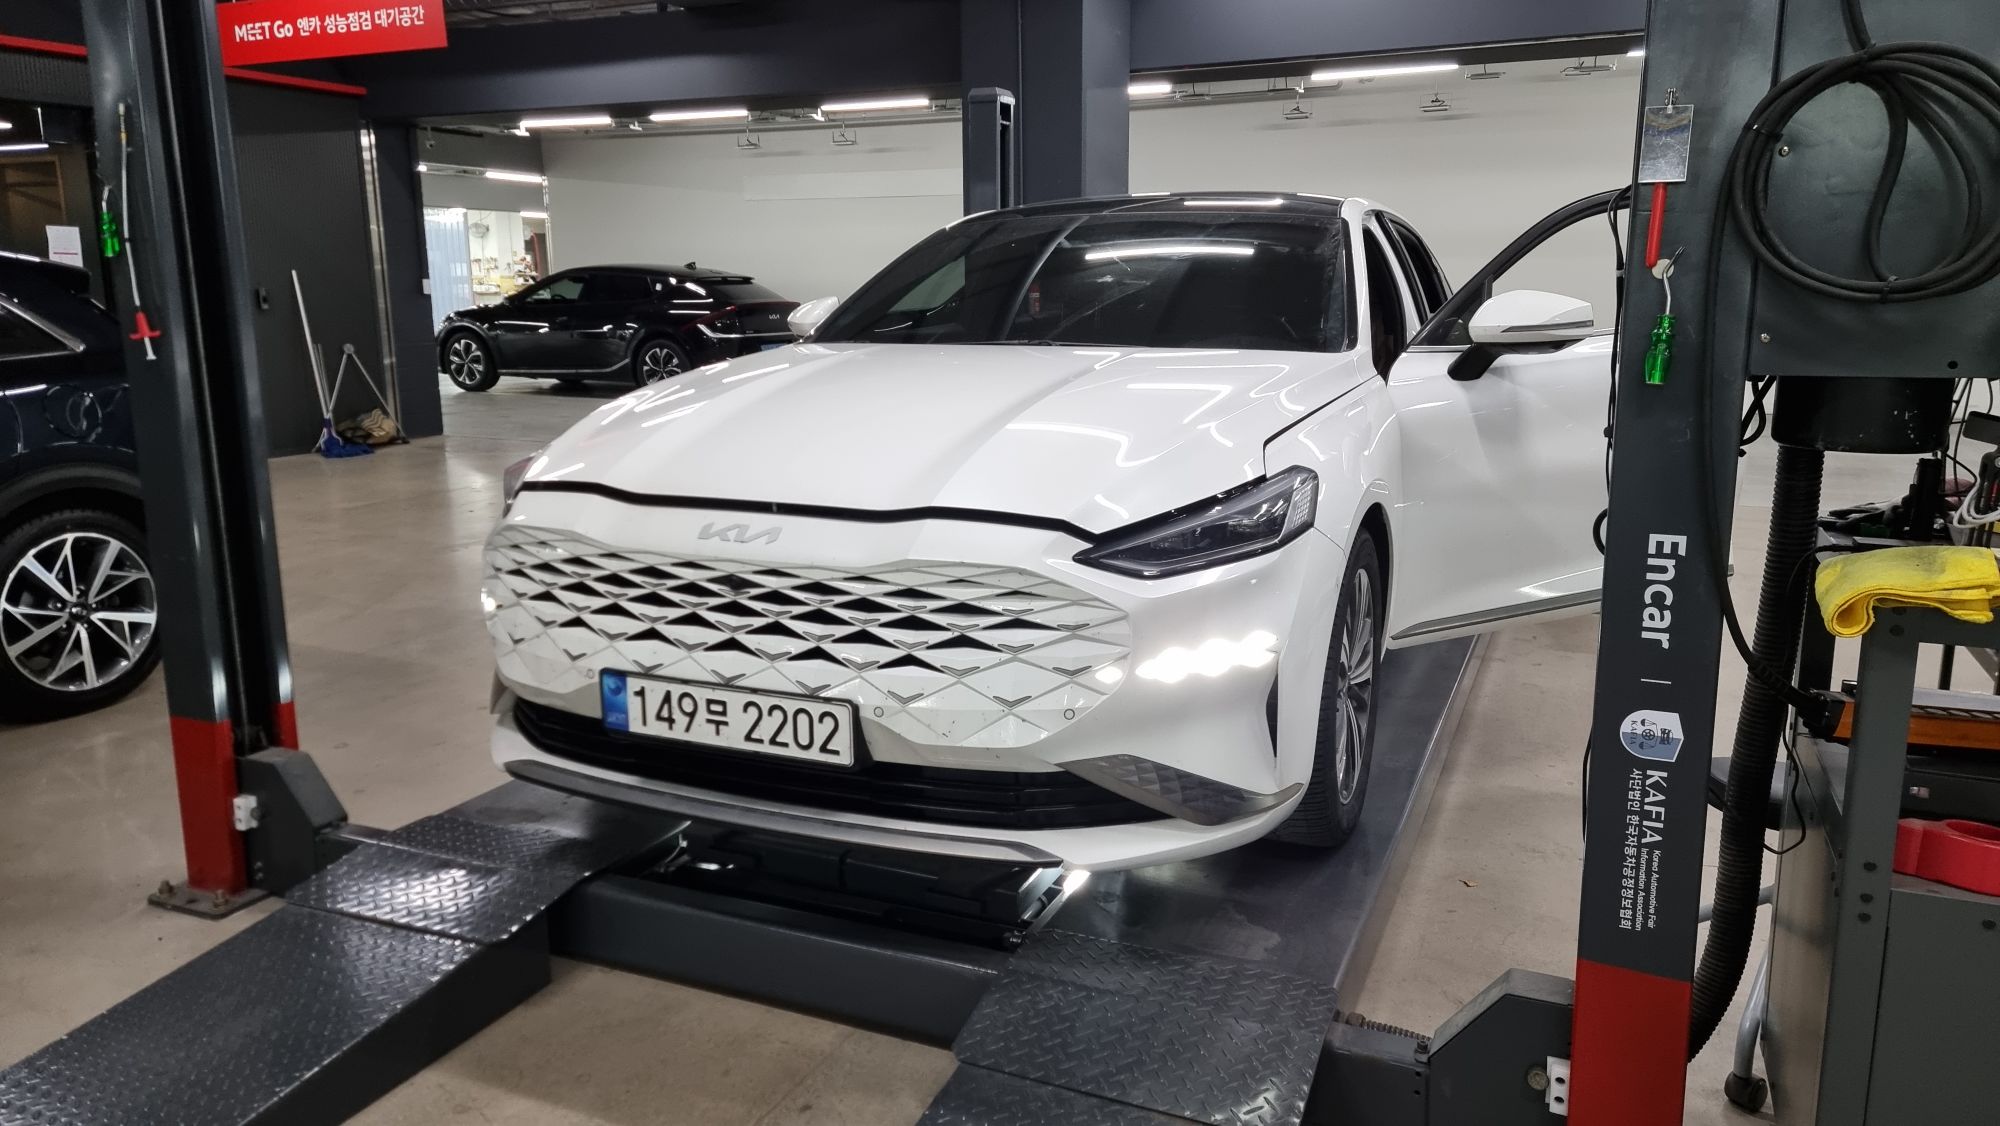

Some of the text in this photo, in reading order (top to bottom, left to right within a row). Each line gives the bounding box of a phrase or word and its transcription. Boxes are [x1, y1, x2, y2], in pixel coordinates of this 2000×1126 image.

[234, 5, 425, 42] MEET Go 엔카 성능점검 대기공간
[1641, 533, 1687, 650] Encar
[633, 685, 841, 756] 149무 2202
[1629, 720, 1638, 745] KAFIA
[1641, 769, 1668, 844] KAFIA
[1619, 768, 1643, 929] 사단법인 한국자동차공정정보협회
[1635, 848, 1649, 931] Information Association
[1648, 849, 1661, 928] Korea Automotive Fair
